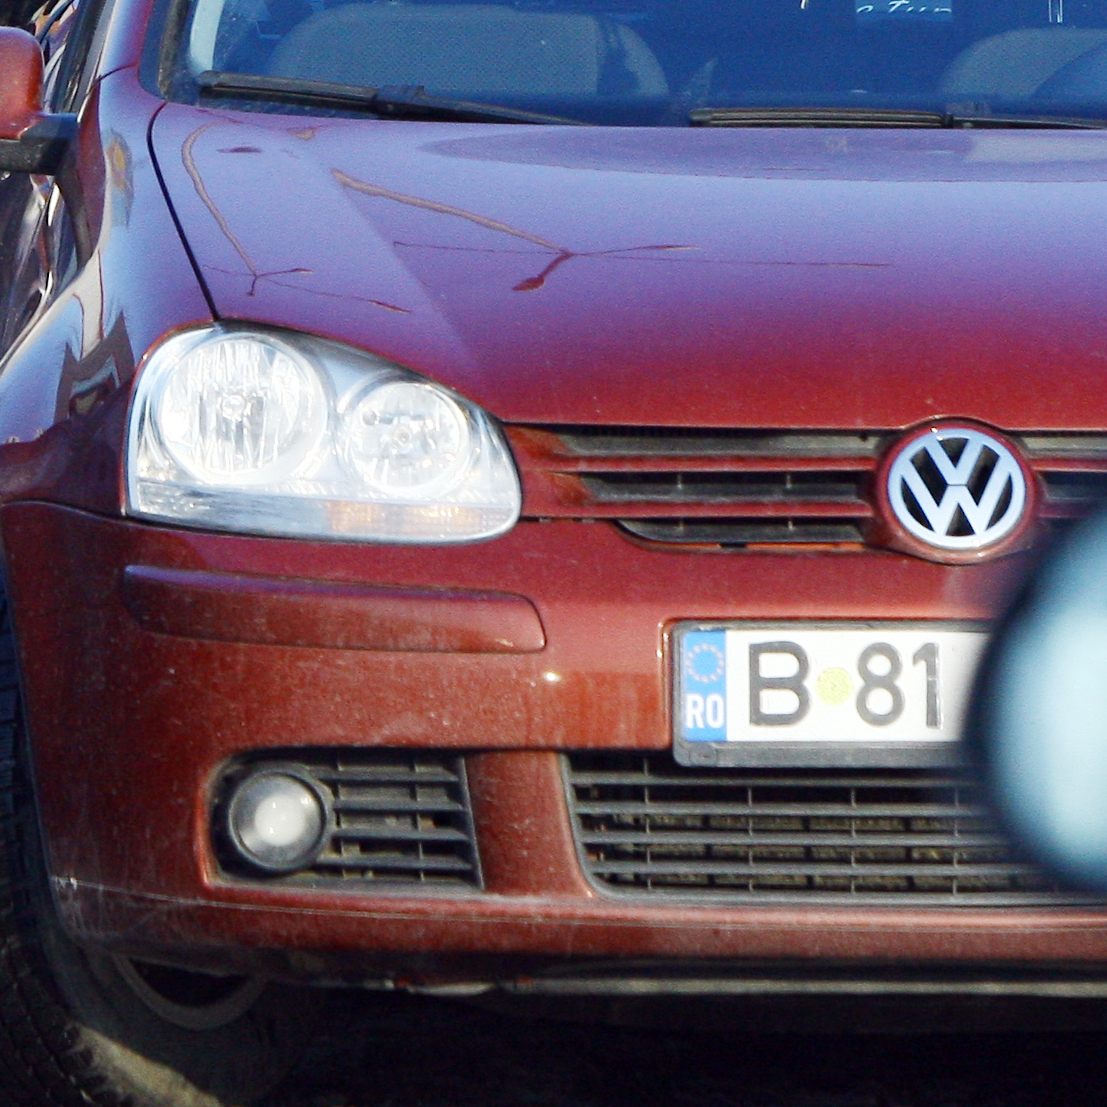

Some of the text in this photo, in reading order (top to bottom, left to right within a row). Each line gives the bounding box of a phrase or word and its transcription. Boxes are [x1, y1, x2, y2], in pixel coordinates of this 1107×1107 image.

[684, 693, 725, 729] RO
[748, 641, 944, 731] B 81
